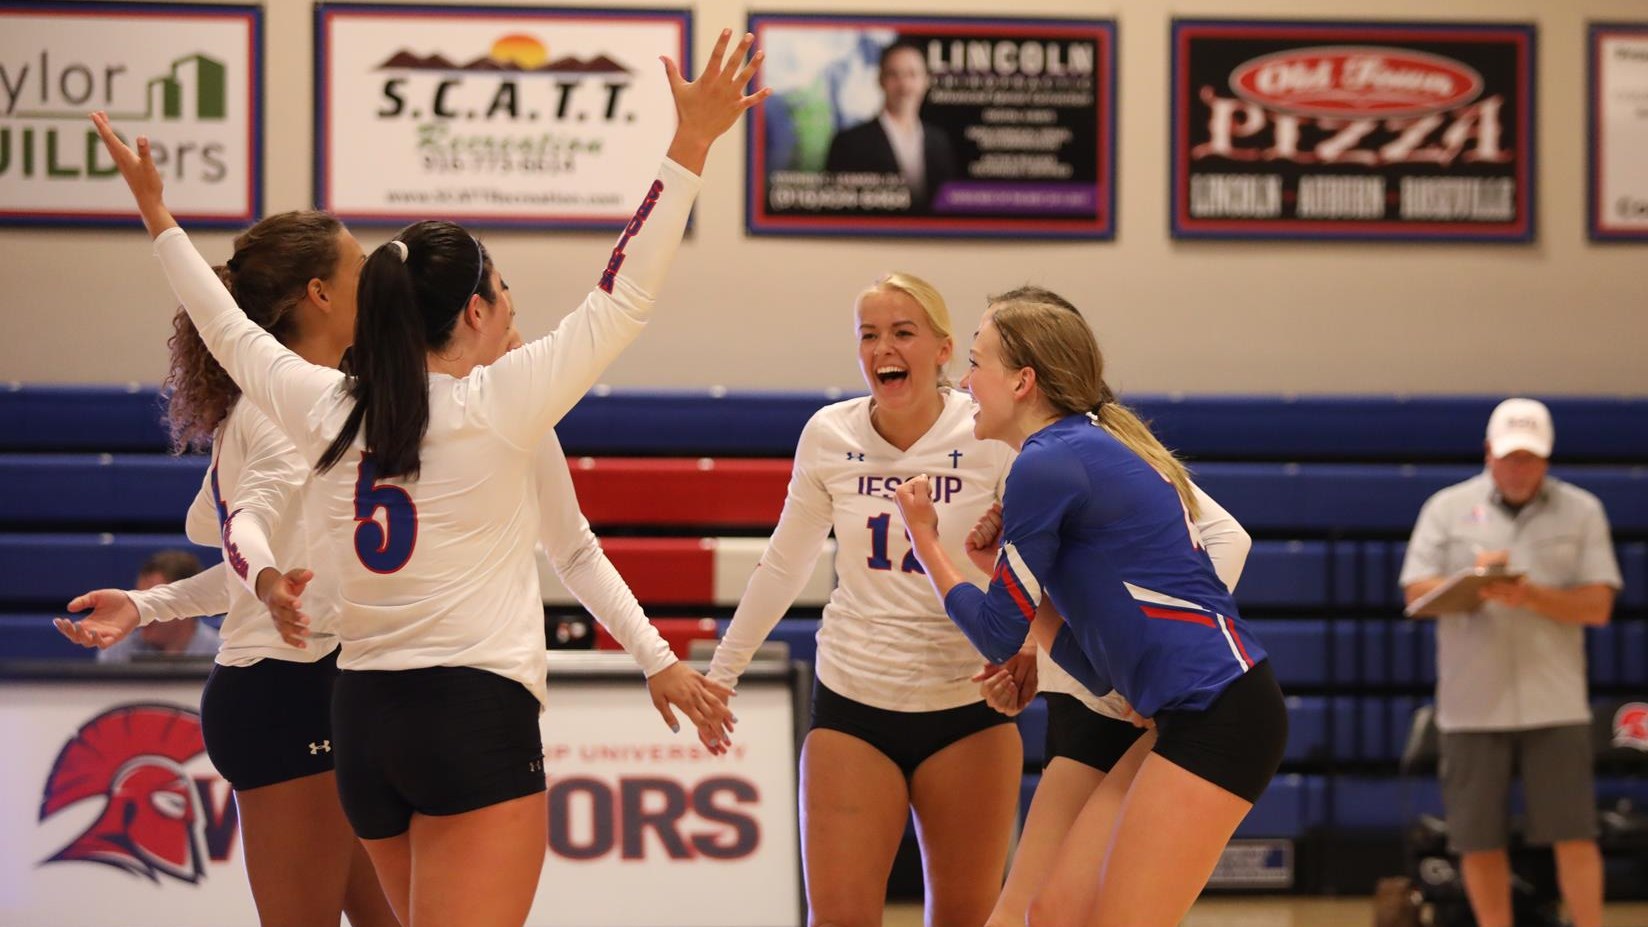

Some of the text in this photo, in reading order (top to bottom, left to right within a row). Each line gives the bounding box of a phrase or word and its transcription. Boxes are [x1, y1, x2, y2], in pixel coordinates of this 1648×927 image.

[929, 41, 1093, 74] LINCOLN
[1256, 56, 1453, 95] Old Town
[376, 77, 638, 122] S.C.A.T.T.
[1193, 90, 1513, 164] PIZZA
[1192, 175, 1281, 216] LINCOLN
[353, 450, 418, 574] 5
[577, 744, 746, 763] UNIVERSY
